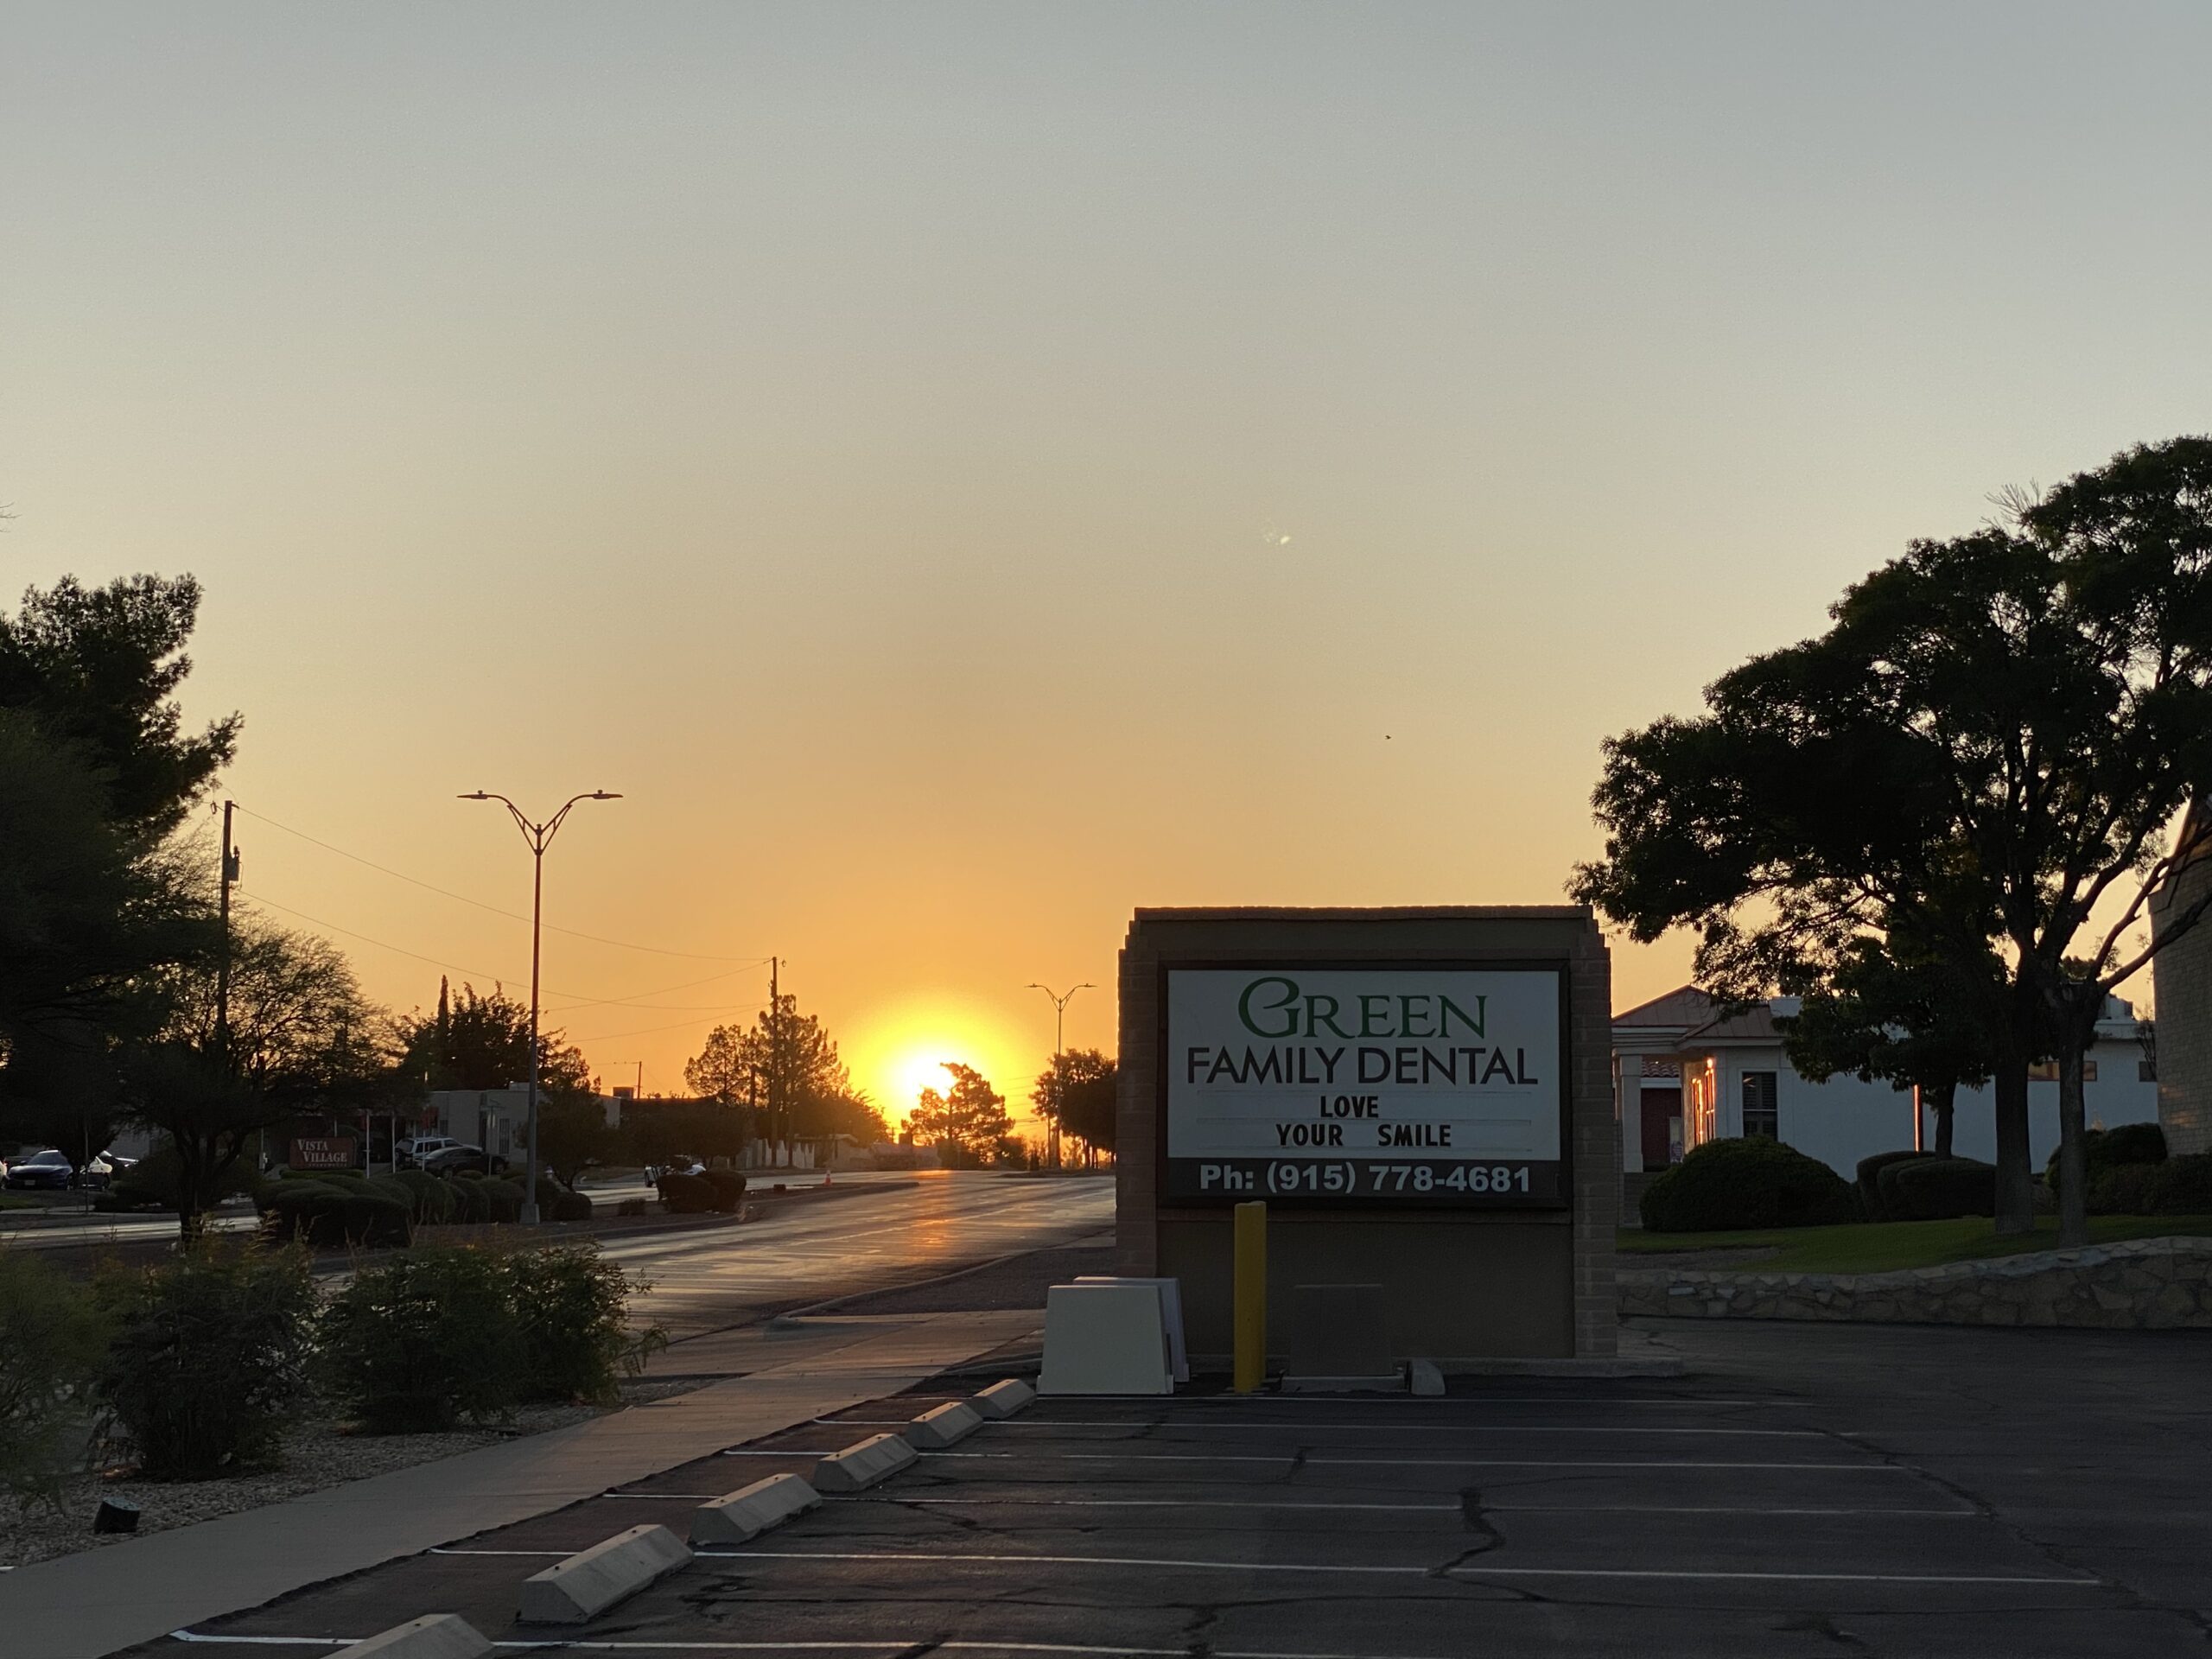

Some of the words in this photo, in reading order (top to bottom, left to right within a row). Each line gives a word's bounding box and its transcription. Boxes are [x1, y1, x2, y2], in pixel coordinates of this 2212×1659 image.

[1238, 976, 1488, 1039] GREEN
[1187, 1046, 1345, 1084] FAMILY
[1358, 1046, 1538, 1085] DENTAL
[1320, 1096, 1379, 1118] LOVE
[297, 1139, 328, 1151] VISTA
[1276, 1124, 1344, 1147] YOUR
[1378, 1124, 1452, 1147] SMILE
[303, 1152, 347, 1162] VILLAGE
[1199, 1164, 1253, 1190] Ph:
[1267, 1161, 1356, 1194] (915)
[1369, 1166, 1530, 1193] 778-4681
